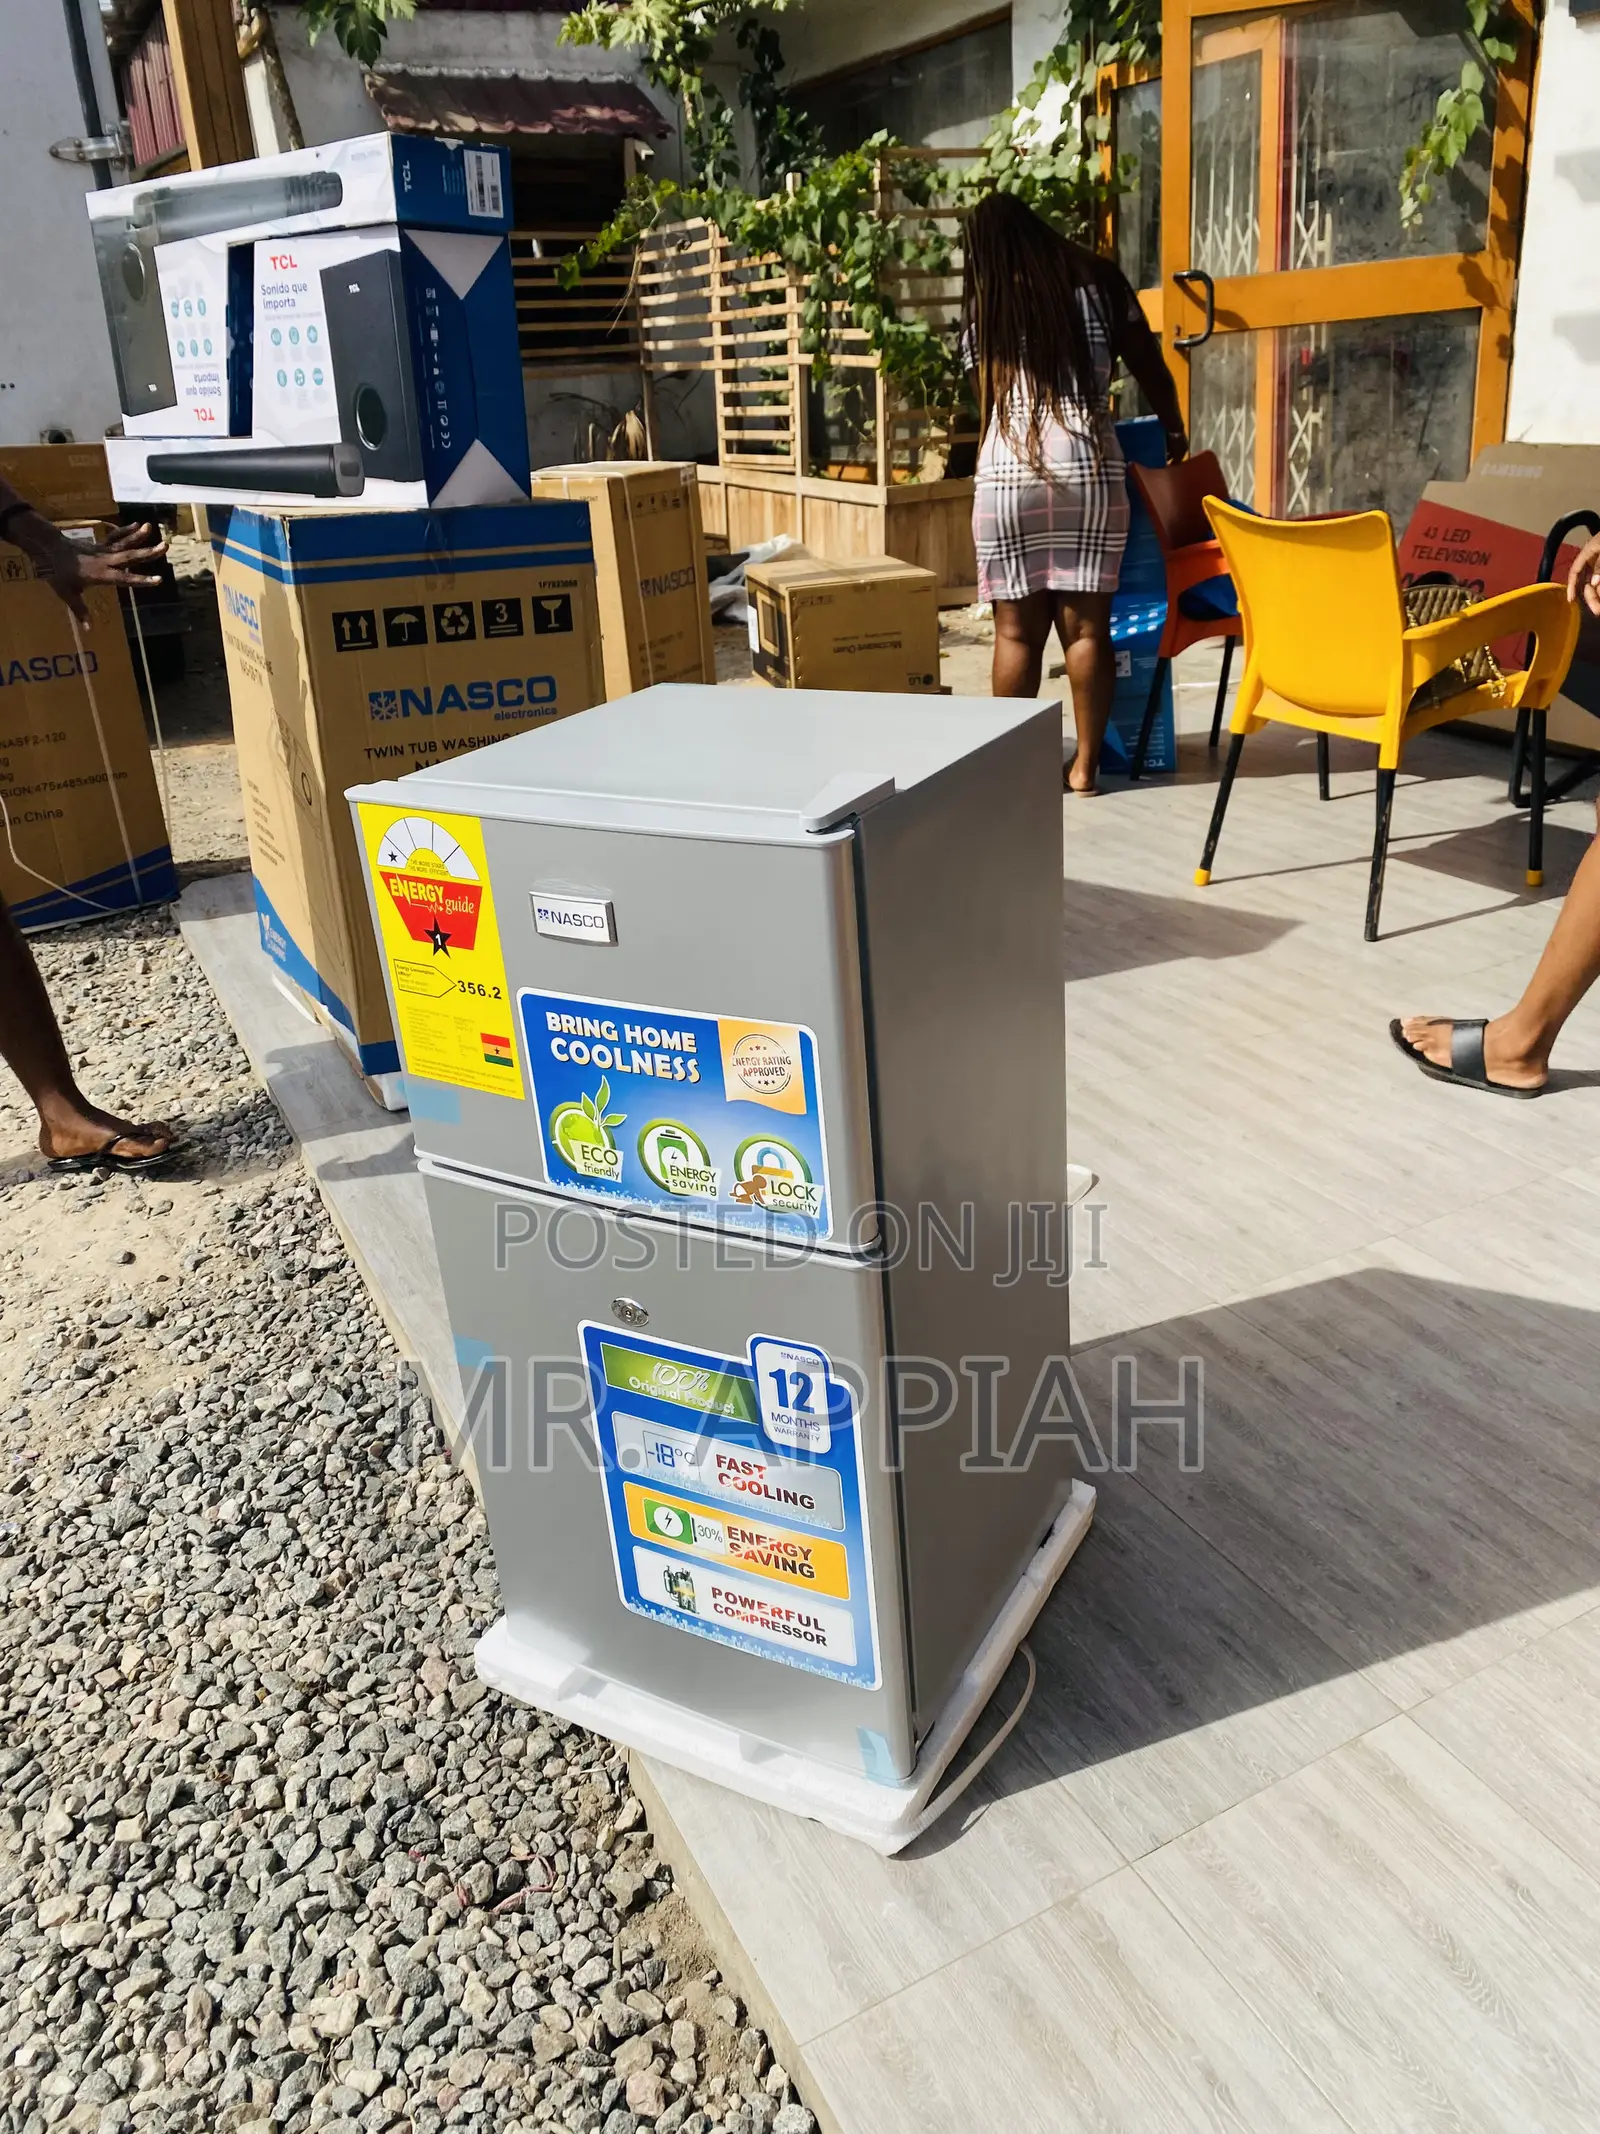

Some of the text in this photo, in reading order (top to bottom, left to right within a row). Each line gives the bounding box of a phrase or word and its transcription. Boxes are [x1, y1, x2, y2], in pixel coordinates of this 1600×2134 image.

[402, 160, 412, 193] TCL
[270, 254, 298, 270] TCL
[260, 281, 308, 296] Sonido que
[193, 407, 215, 421] TCL
[1441, 527, 1471, 544] LED
[1411, 544, 1492, 566] TELEVISION
[651, 566, 696, 597] NASCO
[0, 651, 99, 687] ASCO
[401, 675, 558, 718] NASCO
[494, 706, 558, 721] electronics
[364, 744, 404, 760] TWIN
[408, 741, 437, 755] TUB
[24, 808, 64, 823] China
[389, 873, 444, 905] ENERGY
[445, 896, 475, 915] guide
[551, 911, 605, 929] NASCO
[435, 933, 442, 946] 1
[457, 980, 502, 1000] 356.2
[545, 1011, 698, 1054] BRING HOME
[550, 1037, 701, 1084] COOLNESS
[762, 1055, 792, 1066] RATING
[743, 1066, 786, 1077] APPROVED
[580, 1144, 619, 1166] ECO
[583, 1161, 620, 1181] friendly
[669, 1165, 717, 1184] ENERGY
[672, 1178, 718, 1197] saving
[769, 1180, 818, 1202] LOCK
[772, 1198, 819, 1216] security
[786, 1353, 820, 1366] NASCO
[652, 1361, 711, 1392] 100%
[628, 1376, 736, 1415] Original Product
[769, 1368, 815, 1415] 12
[771, 1411, 821, 1432] MONTHS
[773, 1426, 821, 1443] WARRANTY
[715, 1453, 767, 1480] FAST
[718, 1472, 815, 1510] COOLING
[697, 1523, 723, 1544] 30%
[727, 1525, 813, 1562] ENERGY
[729, 1542, 815, 1579] SAVING
[710, 1586, 826, 1633] POWERFUL
[713, 1602, 828, 1647] COMPRESSOR
